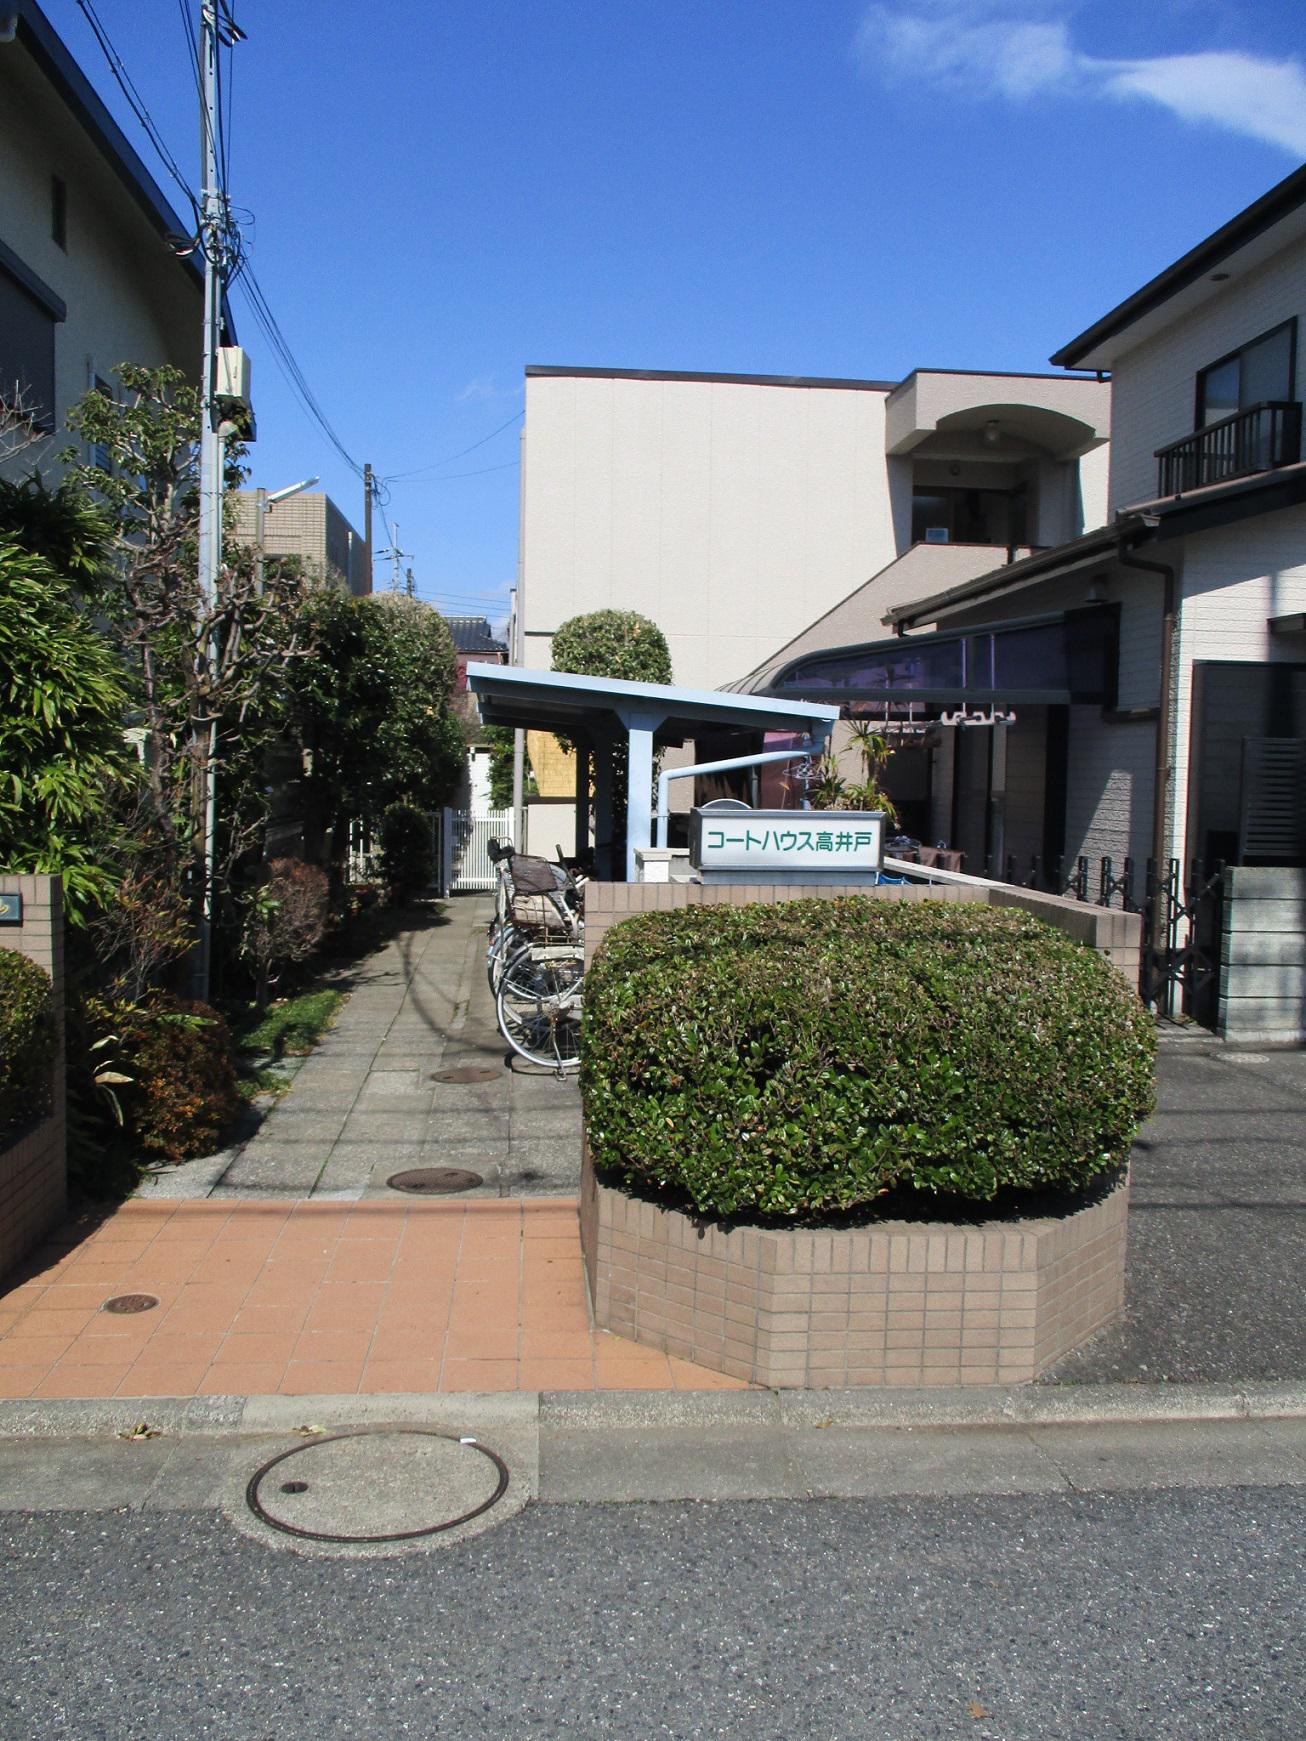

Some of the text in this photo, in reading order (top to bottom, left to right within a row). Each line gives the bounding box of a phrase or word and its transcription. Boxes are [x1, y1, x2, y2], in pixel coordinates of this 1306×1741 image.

[707, 829, 872, 852] コートハウス高井戸
